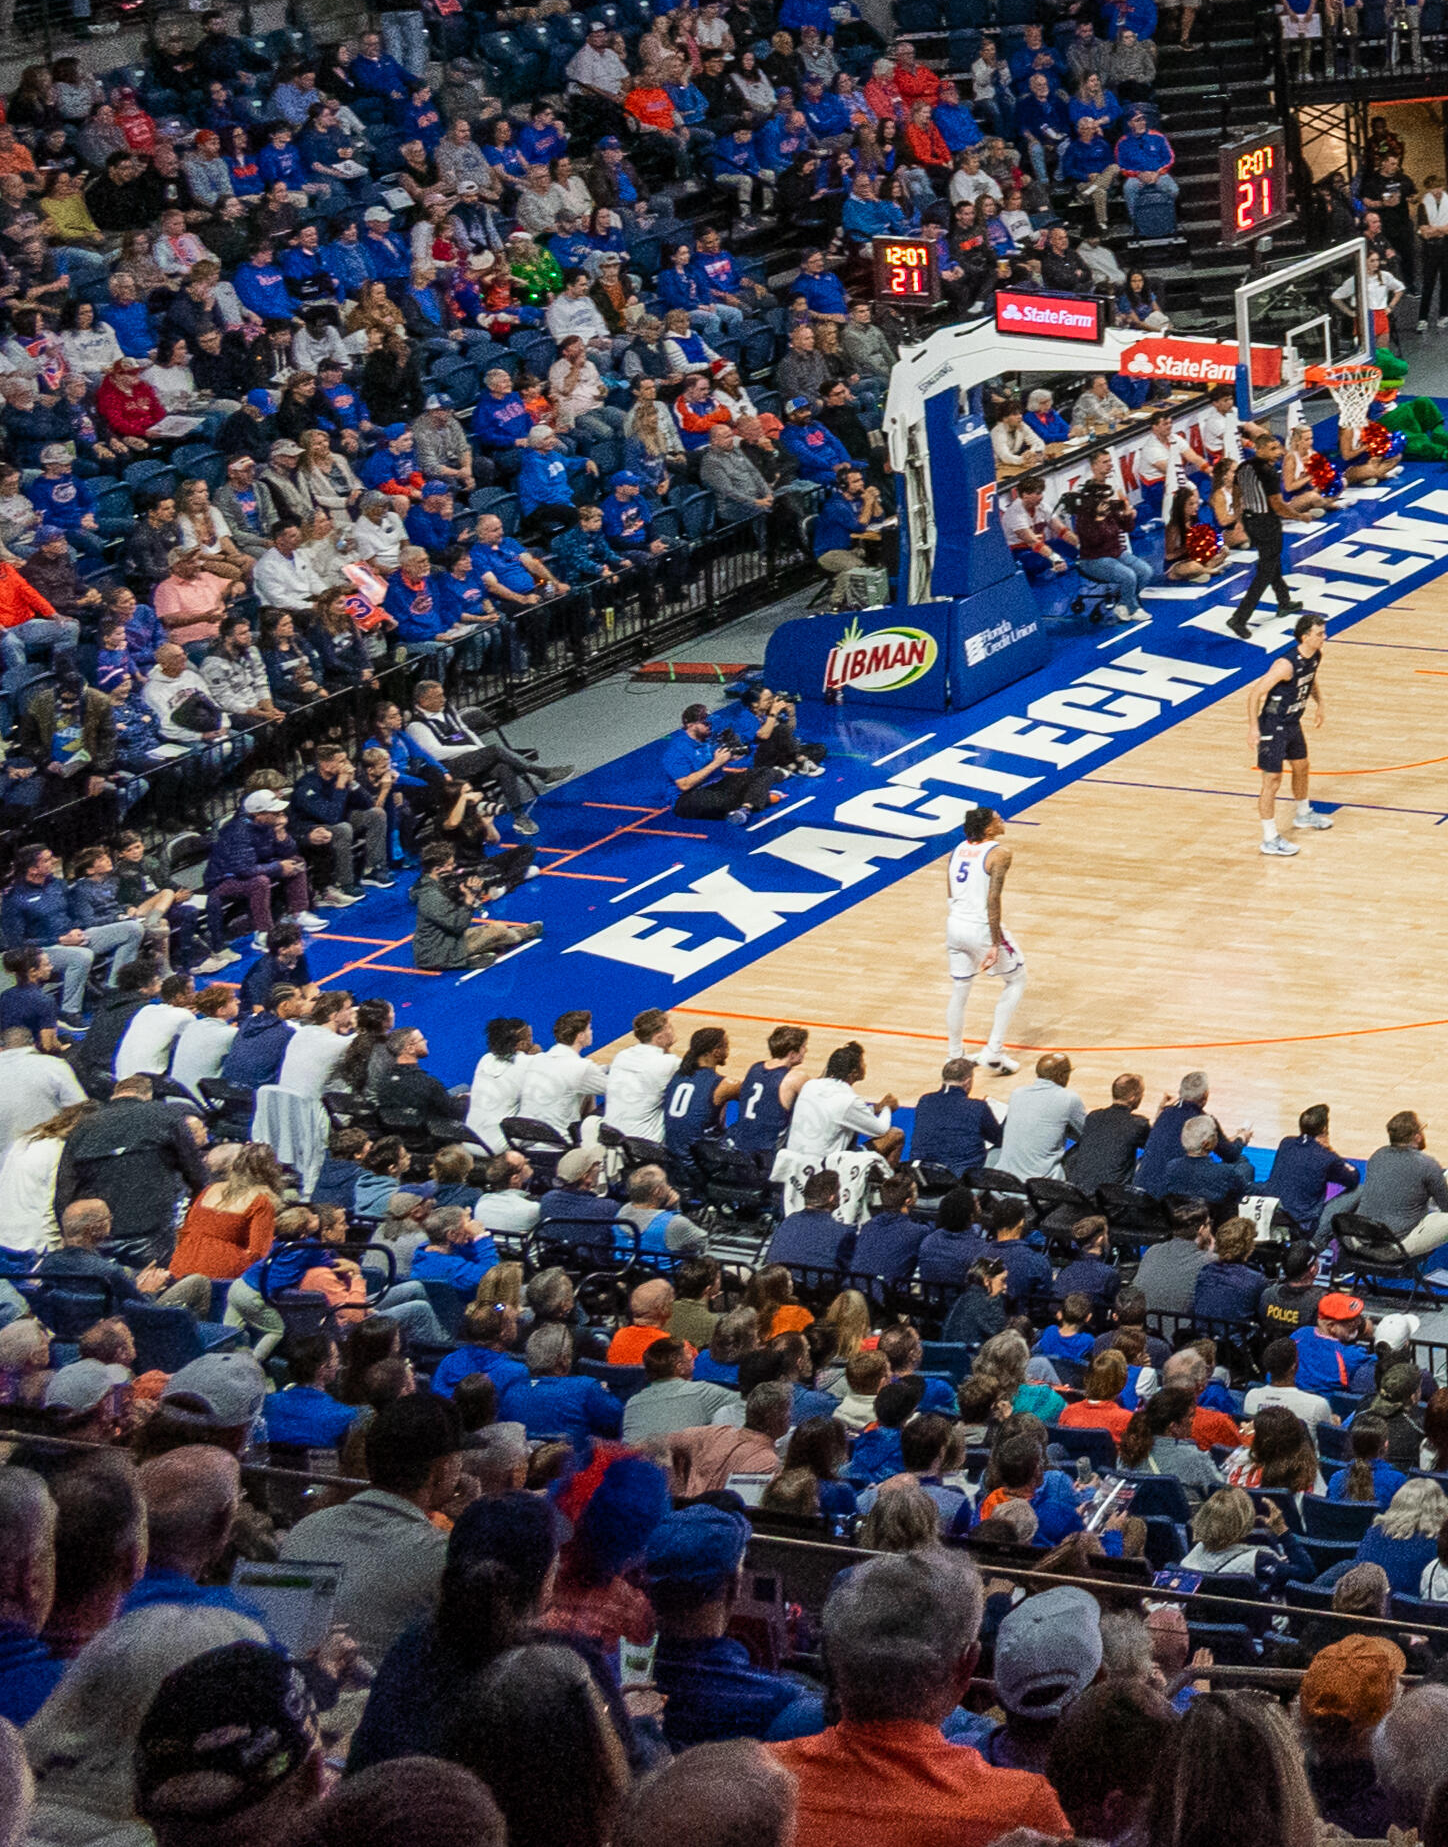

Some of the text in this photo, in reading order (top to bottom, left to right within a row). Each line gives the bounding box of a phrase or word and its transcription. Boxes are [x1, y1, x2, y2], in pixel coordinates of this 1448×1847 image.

[886, 247, 927, 266] 12:07
[891, 267, 922, 294] 21
[1023, 306, 1093, 328] StateFarm
[974, 481, 997, 536] F
[824, 639, 928, 692] LIBMAN
[564, 649, 1240, 983] EXACTECH
[956, 861, 971, 883] 5
[669, 1082, 695, 1118] 0
[745, 1081, 764, 1120] 2
[1266, 1303, 1300, 1324] POLICE
